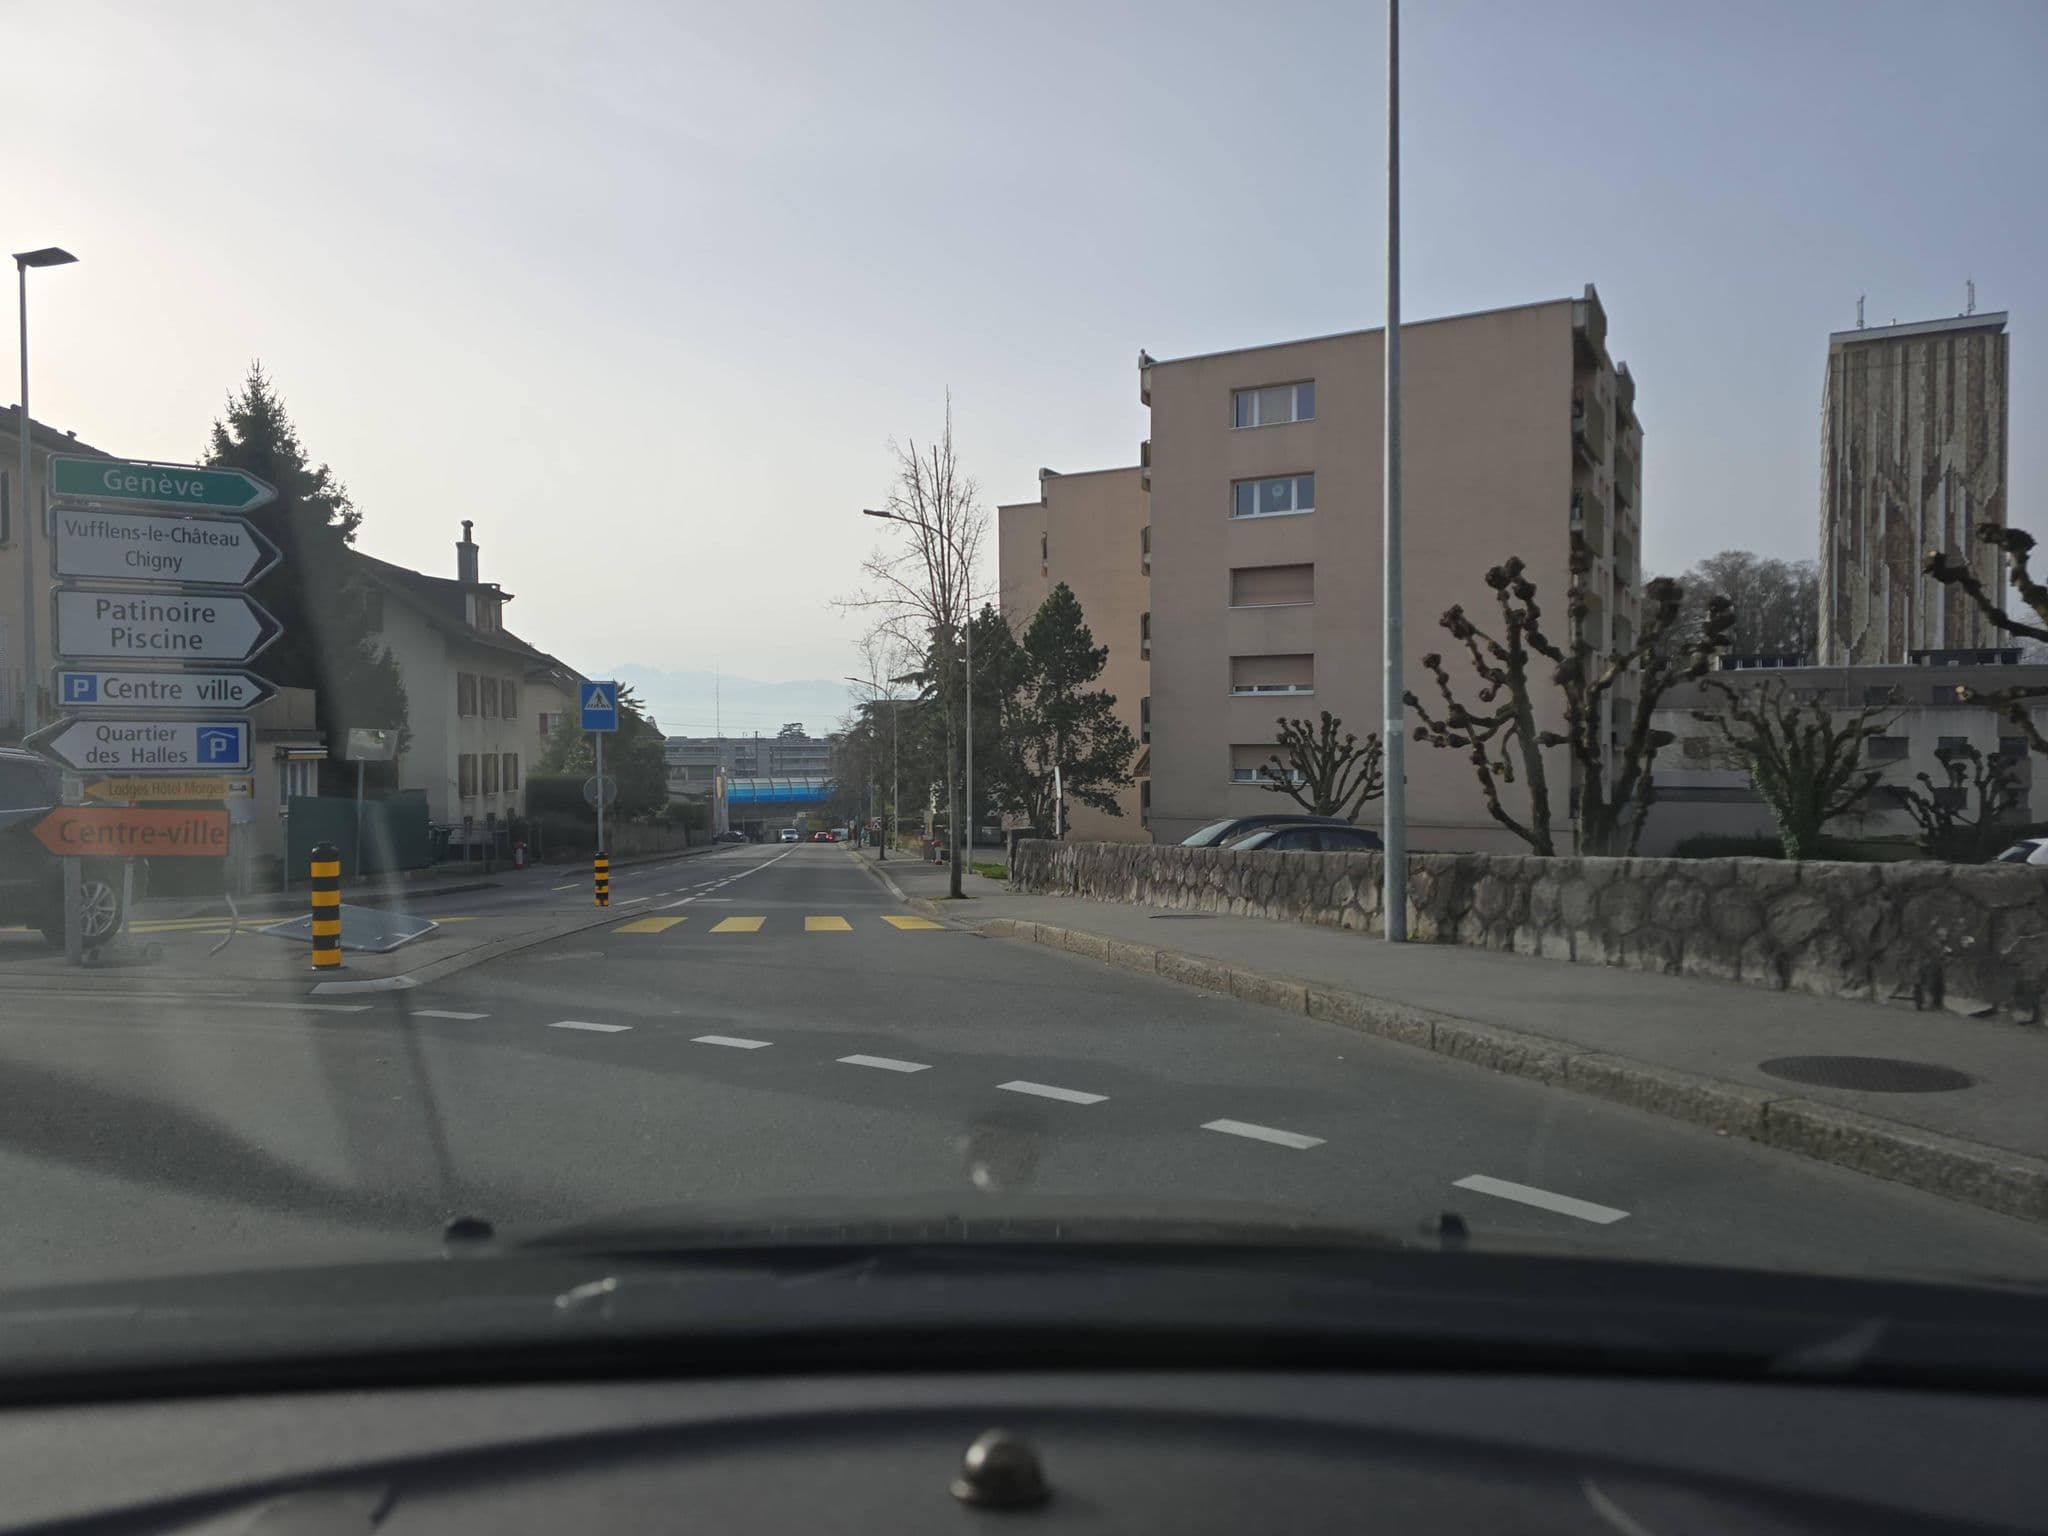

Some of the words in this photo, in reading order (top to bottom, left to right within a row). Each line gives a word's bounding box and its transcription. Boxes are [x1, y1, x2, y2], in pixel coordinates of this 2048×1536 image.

[104, 470, 204, 496] Genève
[64, 520, 240, 546] Vufflens-le-Château
[125, 551, 183, 573] Chigny
[96, 599, 216, 623] Patinoire
[111, 627, 203, 650] Piscine
[73, 679, 90, 698] P
[103, 678, 183, 699] Centre
[196, 680, 243, 701] ville
[96, 725, 177, 743] Quartier
[86, 747, 120, 764] des
[132, 747, 188, 764] Halles
[209, 738, 228, 760] P
[108, 781, 149, 799] Lodges
[153, 781, 180, 796] Hôtel
[184, 783, 224, 799] Morges
[60, 819, 225, 845] Centre-ville
